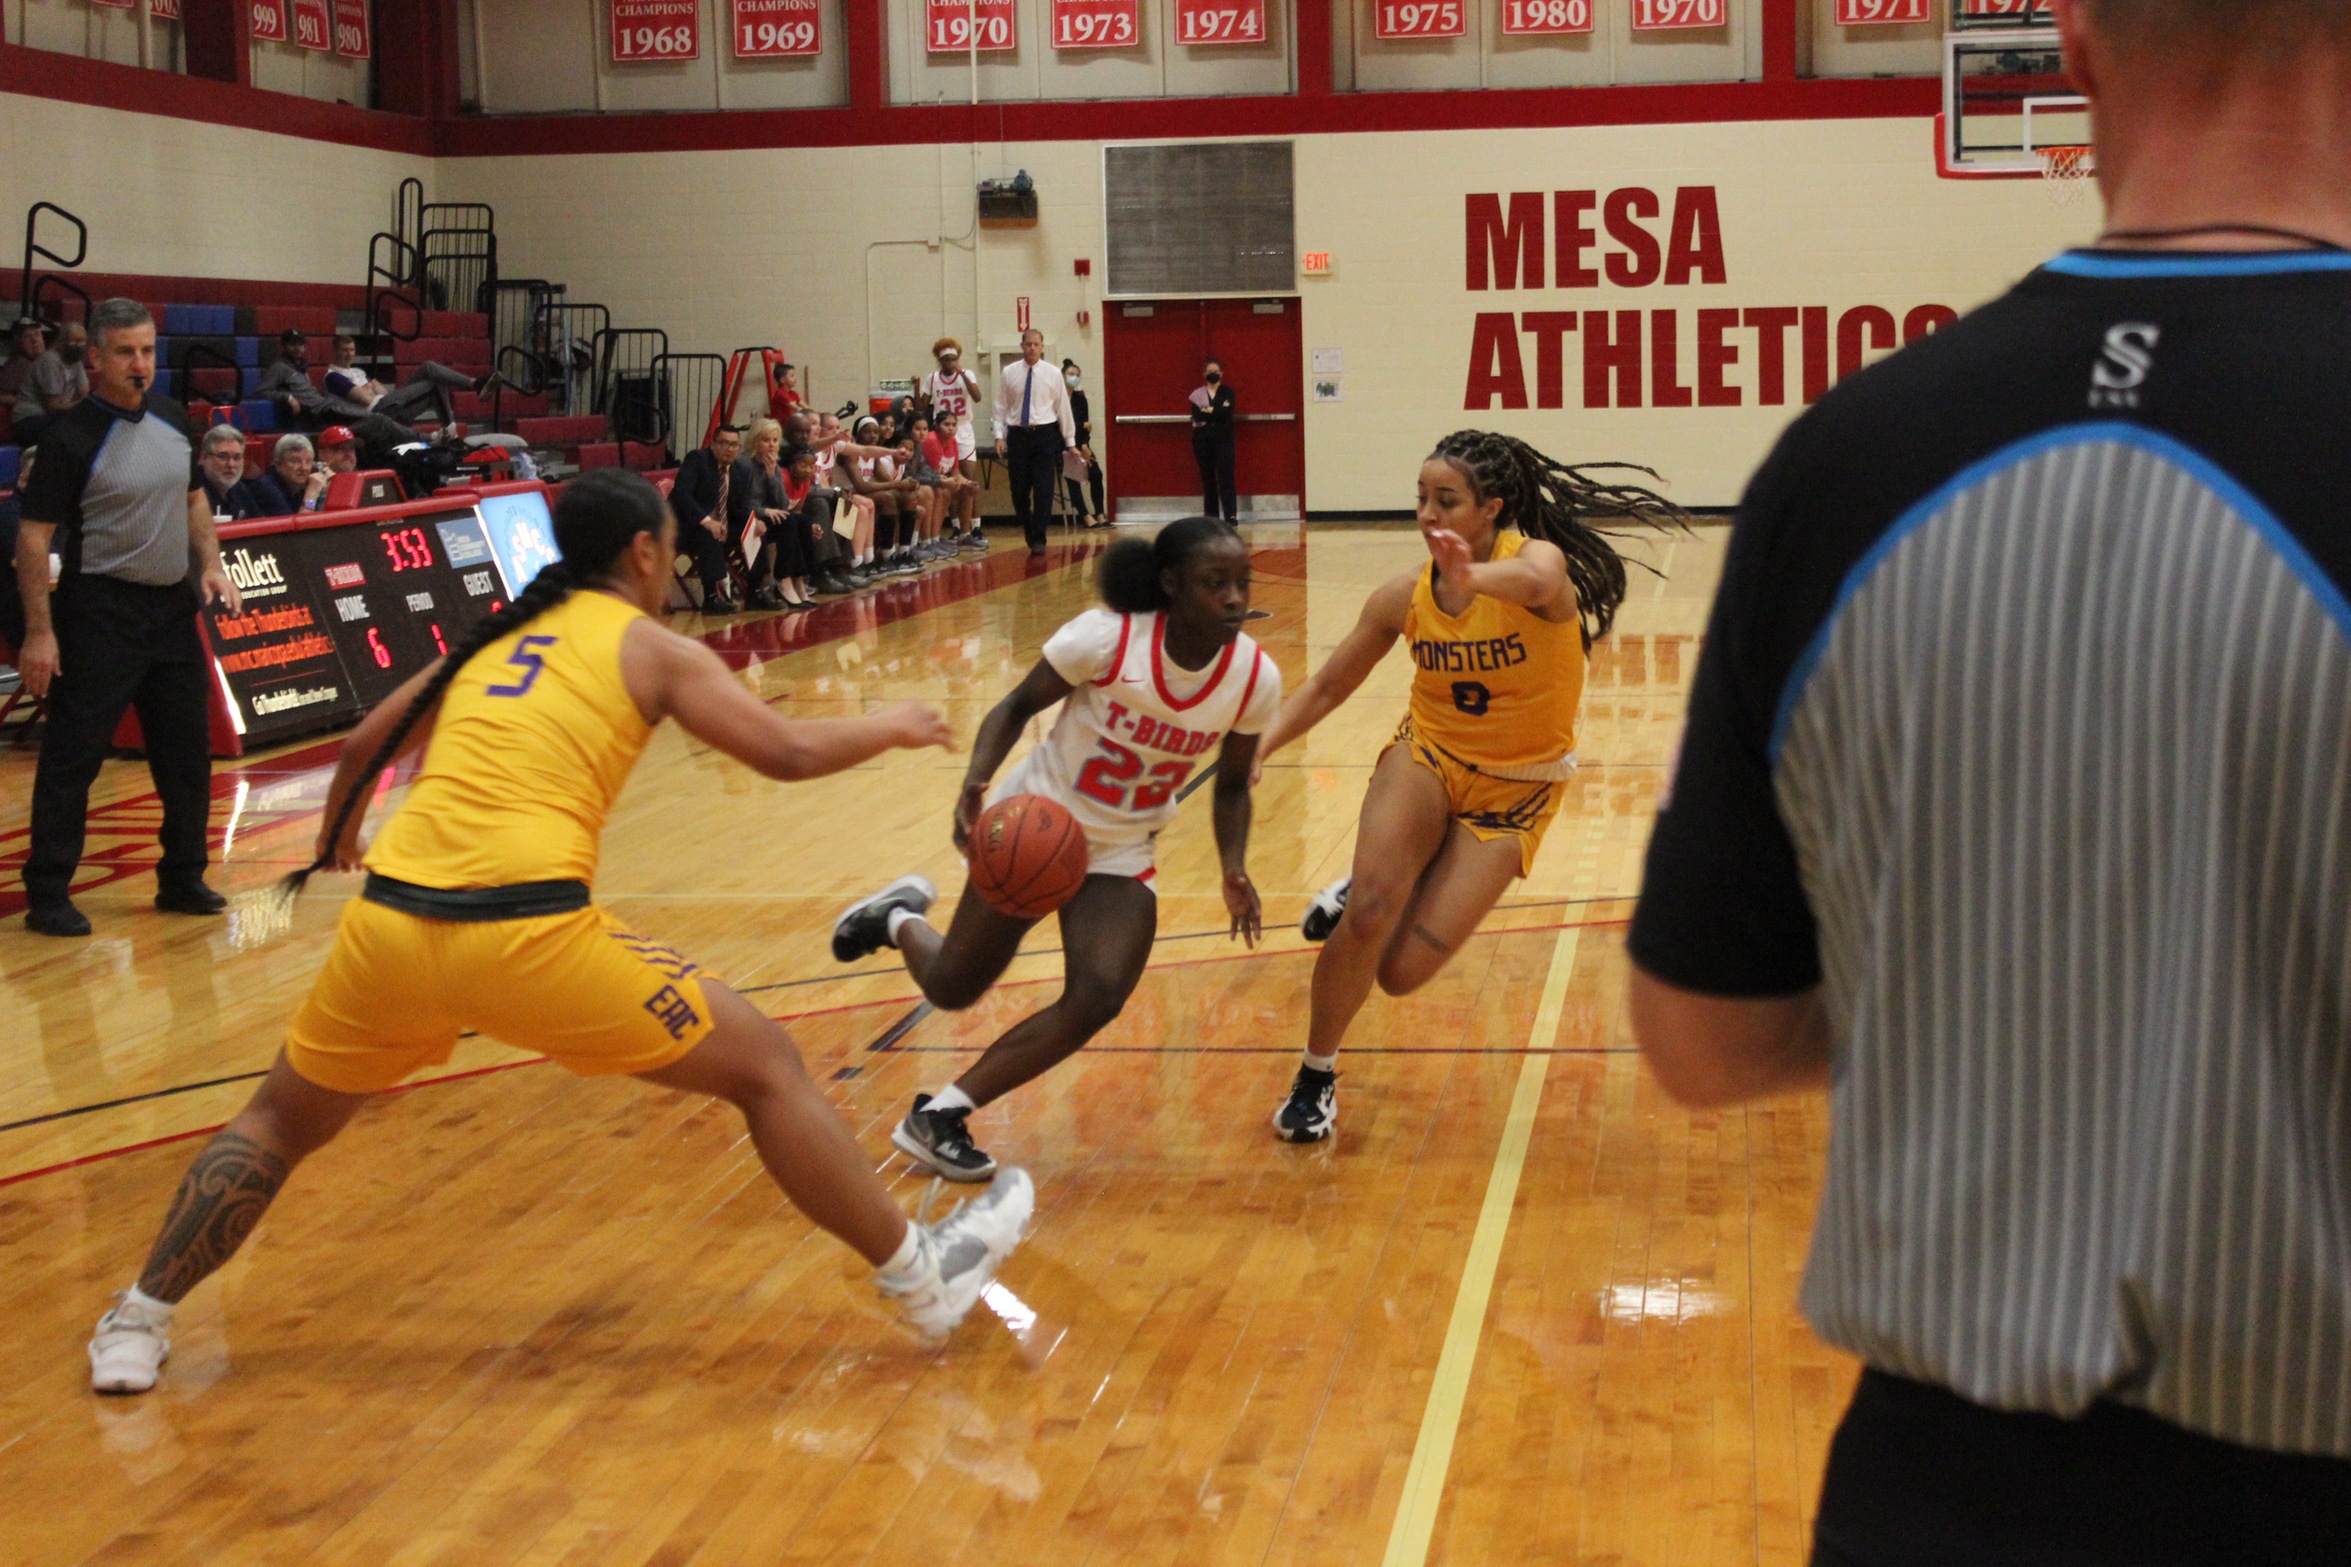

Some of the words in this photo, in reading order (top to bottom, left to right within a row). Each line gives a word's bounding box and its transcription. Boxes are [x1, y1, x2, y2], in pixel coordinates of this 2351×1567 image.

[253, 4, 277, 34] 999
[616, 4, 694, 16] CHAMPIONS
[738, 0, 816, 12] CHAMPIONS
[1383, 3, 1459, 33] 1975
[1510, 0, 1587, 28] 1980
[1640, 0, 1717, 24] 1970
[298, 14, 321, 43] 981
[338, 23, 361, 52] 980
[742, 22, 815, 51] 1969
[934, 17, 1008, 46] 1970
[1059, 13, 1132, 42] 1973
[1183, 9, 1259, 39] 1974
[620, 26, 692, 55] 1968
[1465, 186, 1727, 291] MESA
[1306, 253, 1329, 271] EXIT
[380, 527, 433, 573] 3:53
[463, 570, 494, 597] GUEST
[334, 594, 371, 623] HOME
[366, 626, 393, 669] 6
[1413, 632, 1527, 673] MONSTERS
[486, 635, 558, 697] 5
